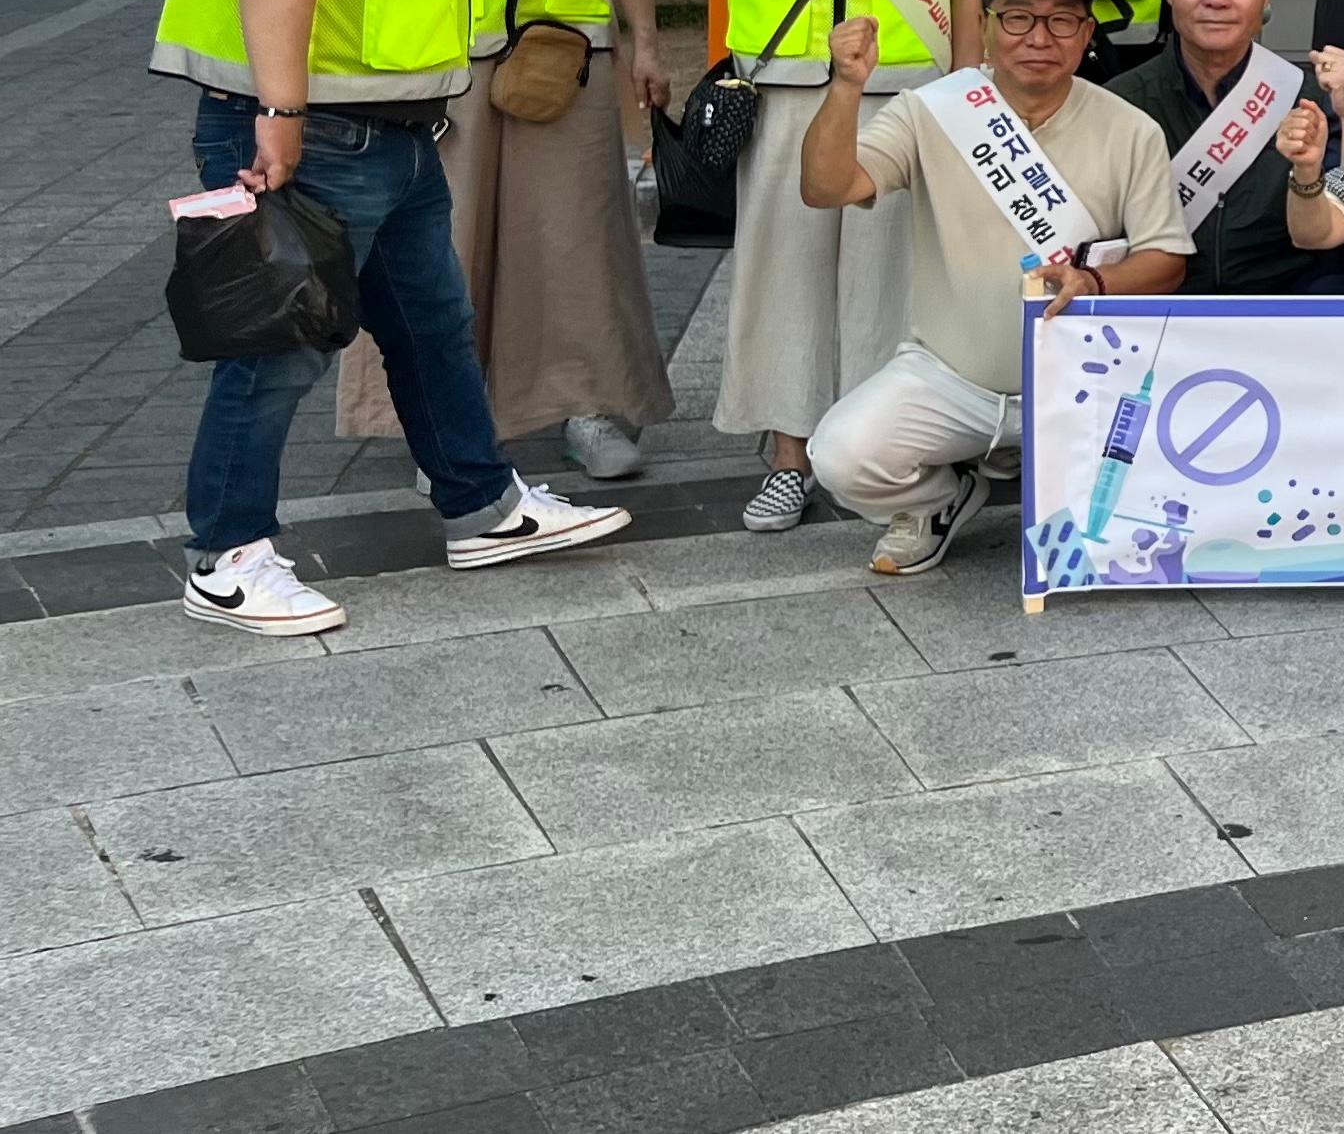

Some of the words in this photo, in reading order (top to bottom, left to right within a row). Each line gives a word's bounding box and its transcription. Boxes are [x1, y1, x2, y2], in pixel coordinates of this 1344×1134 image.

[1243, 81, 1276, 125] 마약
[965, 85, 998, 109] 약
[987, 112, 1031, 162] 하지
[1022, 162, 1067, 211] 말자
[1206, 121, 1249, 165] 대신
[972, 142, 1017, 192] 우리
[1010, 194, 1056, 245] 청춘
